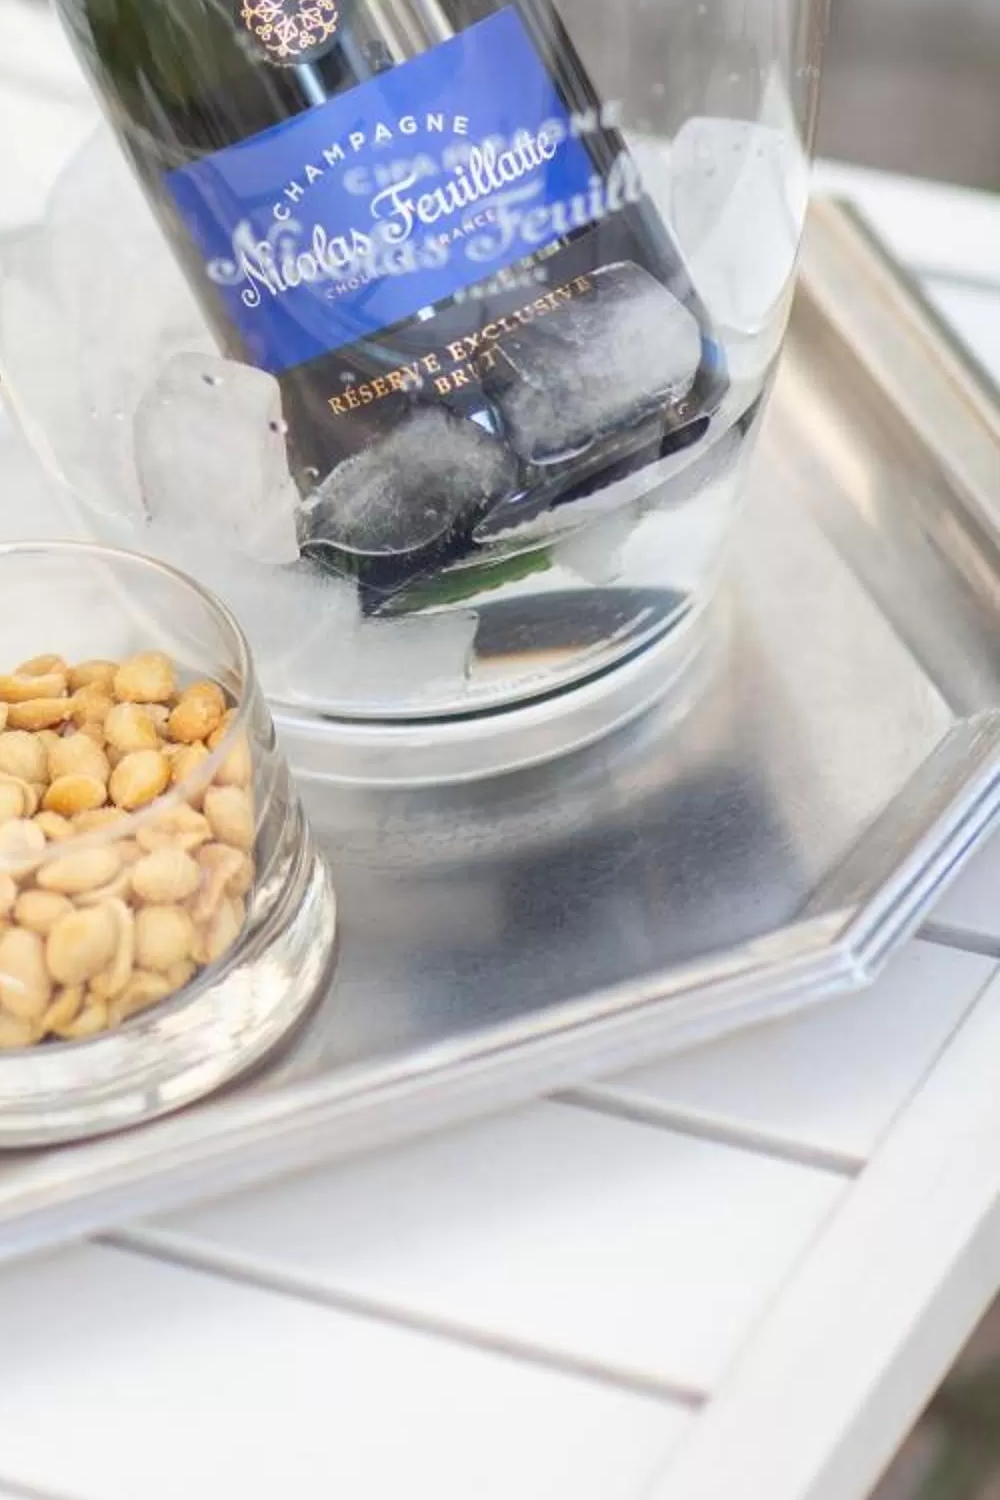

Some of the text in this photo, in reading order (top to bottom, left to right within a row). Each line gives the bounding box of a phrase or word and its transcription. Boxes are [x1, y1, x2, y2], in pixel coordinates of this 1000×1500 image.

[272, 112, 470, 221] CHAMPAGNE
[241, 223, 372, 308] Nicolas
[370, 128, 558, 244] Feuillatte
[435, 207, 497, 246] RANCE
[446, 274, 591, 362] EXCLUSIVE
